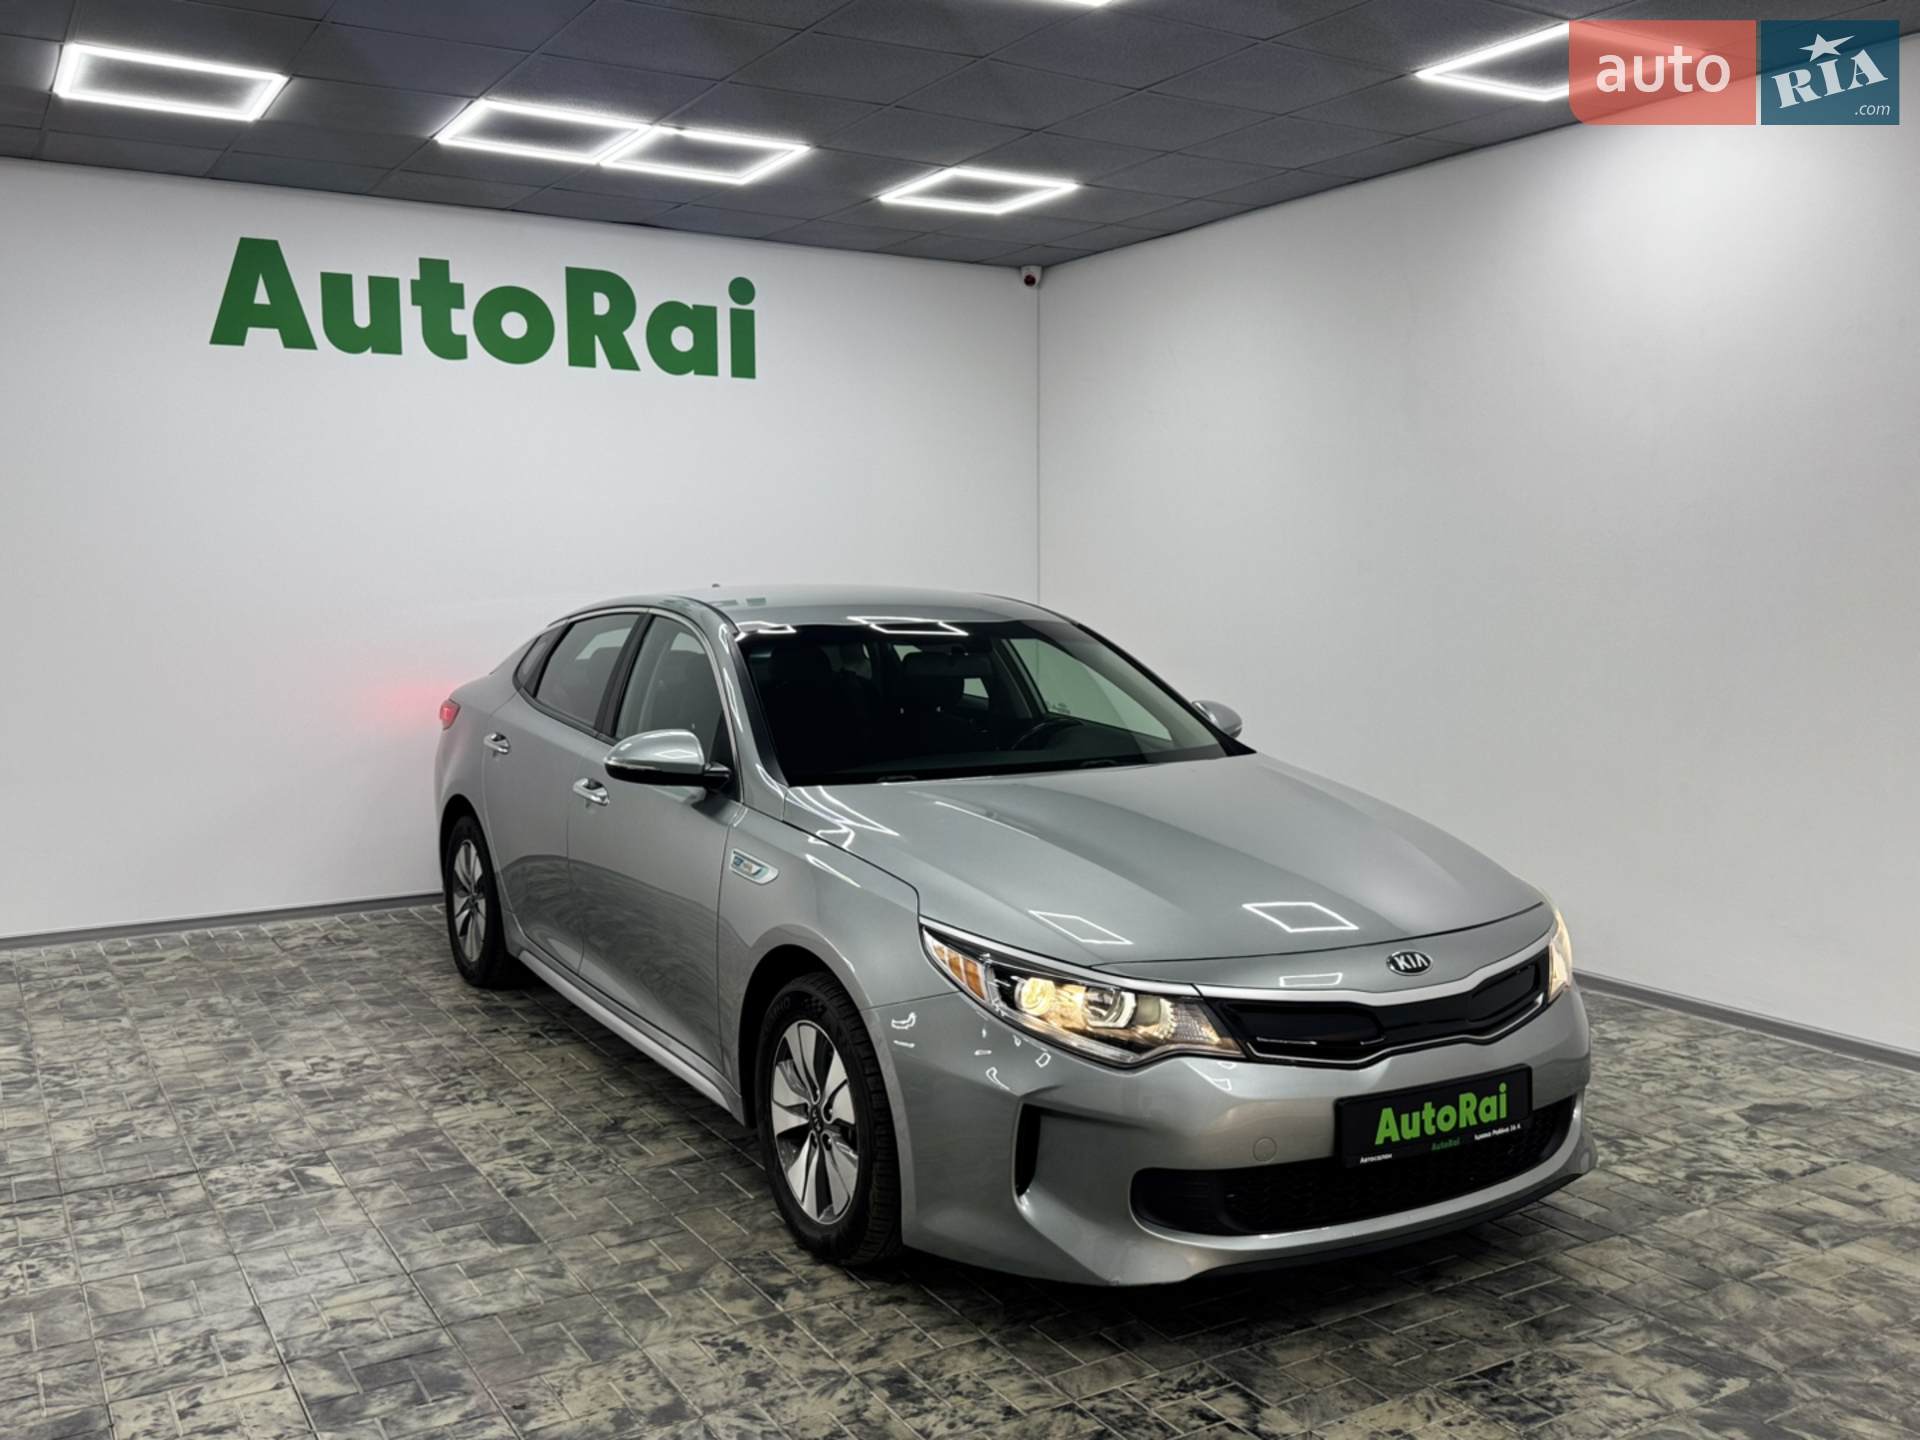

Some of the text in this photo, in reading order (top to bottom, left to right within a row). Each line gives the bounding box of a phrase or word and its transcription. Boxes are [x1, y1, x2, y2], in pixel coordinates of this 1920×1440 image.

[209, 236, 757, 379] AutoRai
[1393, 953, 1429, 970] KIA
[1374, 1082, 1507, 1145] AutoRai
